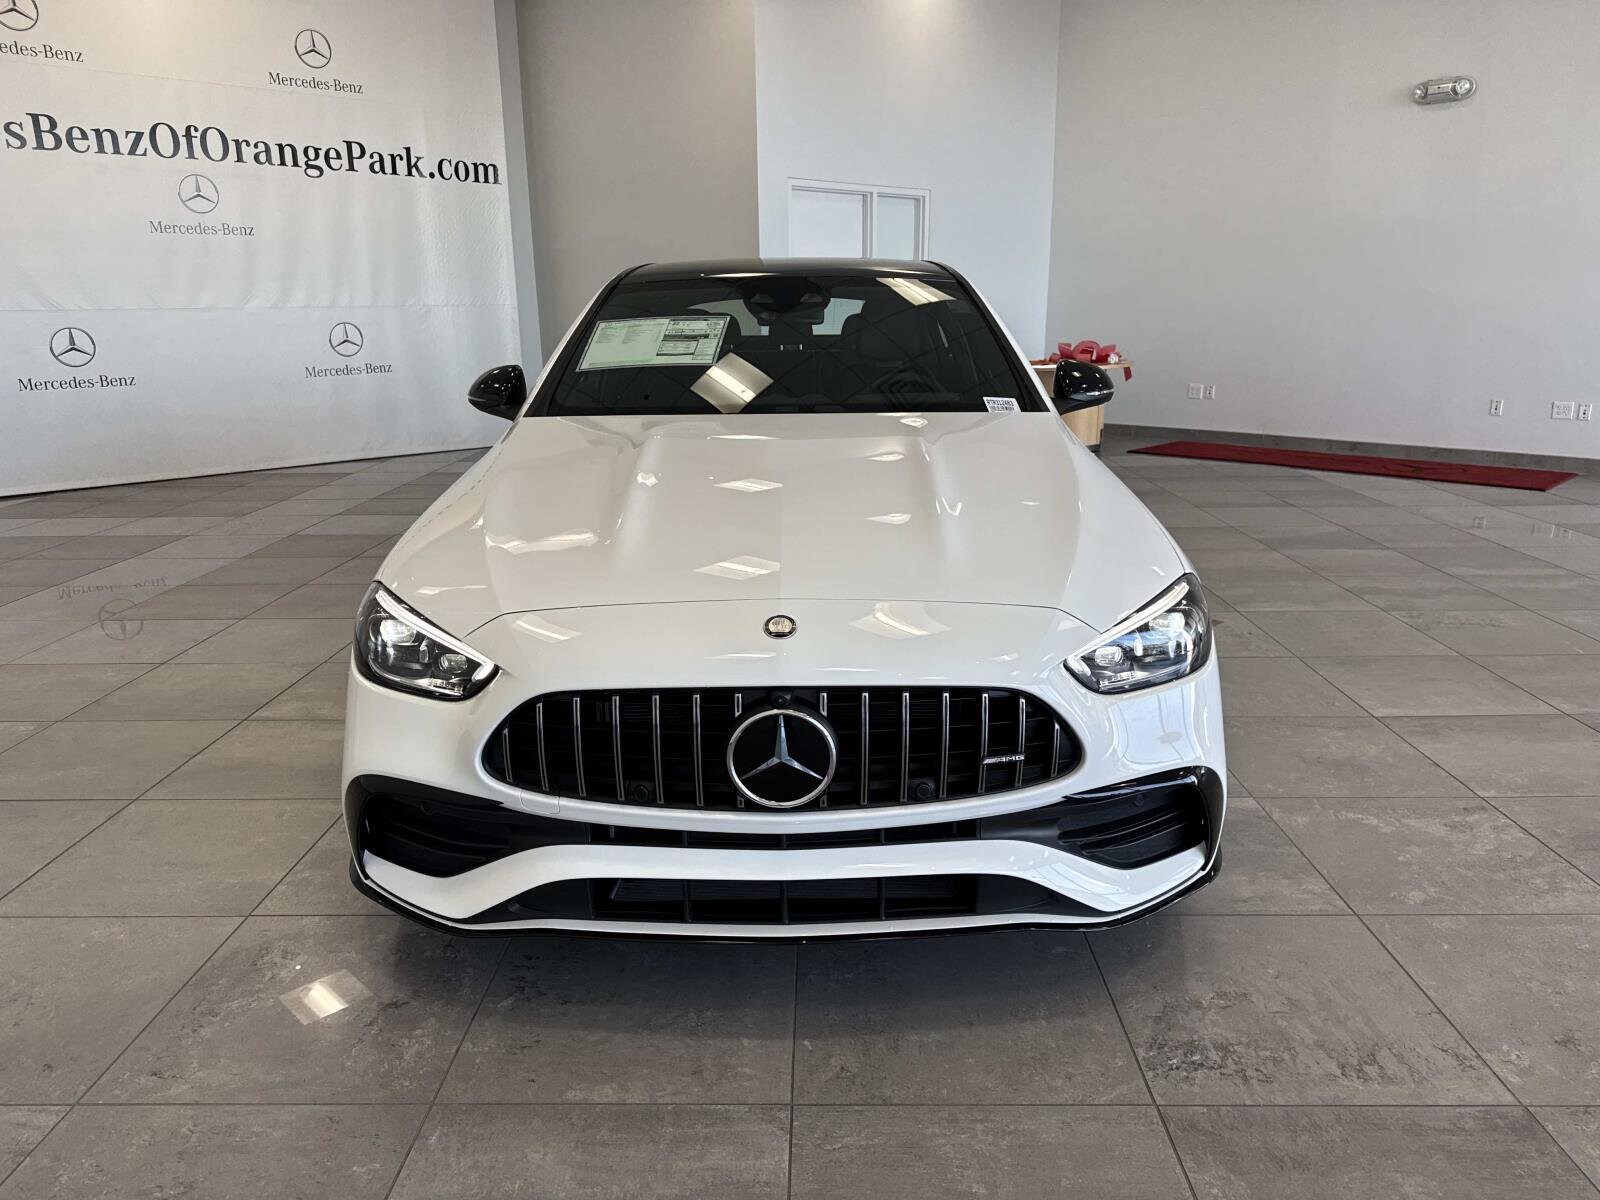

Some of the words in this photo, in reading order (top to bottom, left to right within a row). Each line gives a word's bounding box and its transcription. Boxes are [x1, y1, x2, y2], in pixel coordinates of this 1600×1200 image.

[268, 72, 364, 94] Mercedes-Benz
[2, 112, 502, 185] sBenzOfOrangePark.com
[149, 220, 255, 236] Mercedes-Benz
[304, 362, 393, 379] Mercedes-Benz
[18, 374, 137, 392] Mercedes-Benz
[994, 755, 1024, 763] AMG
